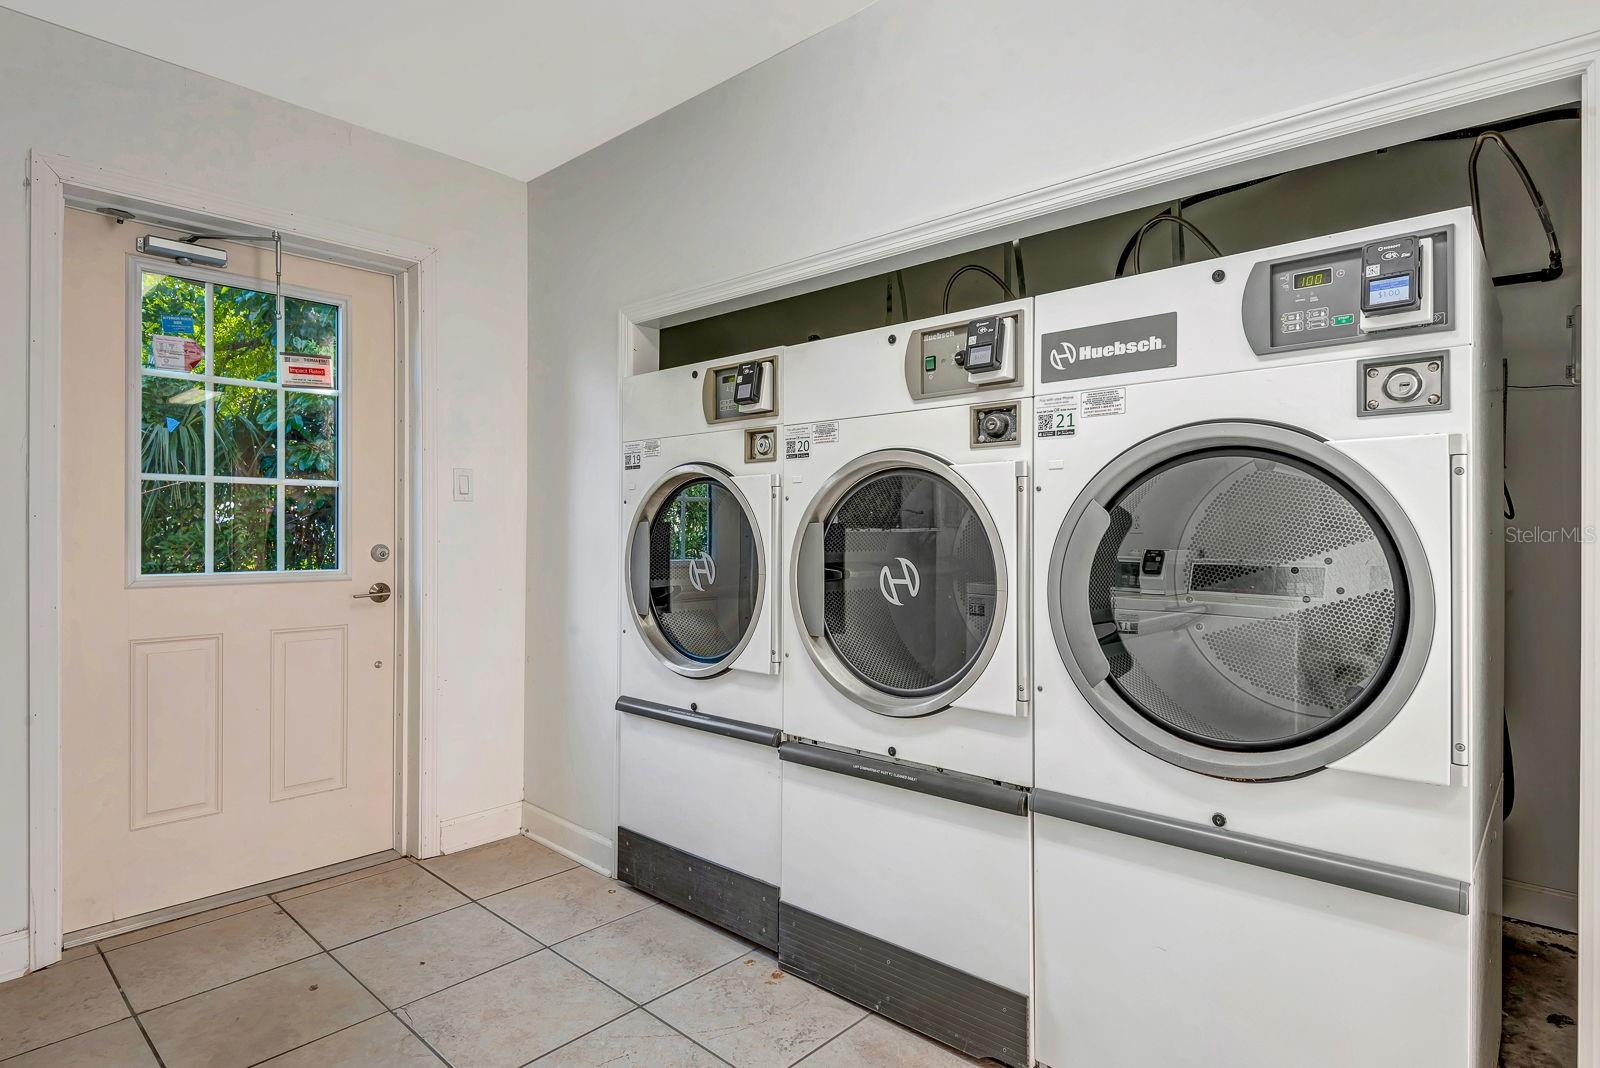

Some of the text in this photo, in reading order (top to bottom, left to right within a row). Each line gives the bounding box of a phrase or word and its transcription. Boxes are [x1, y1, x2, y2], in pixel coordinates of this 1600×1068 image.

[1079, 335, 1163, 361] Huebsch
[289, 367, 308, 375] Impact
[1056, 412, 1075, 429] 21
[797, 440, 810, 452] 20
[632, 454, 641, 465] 19
